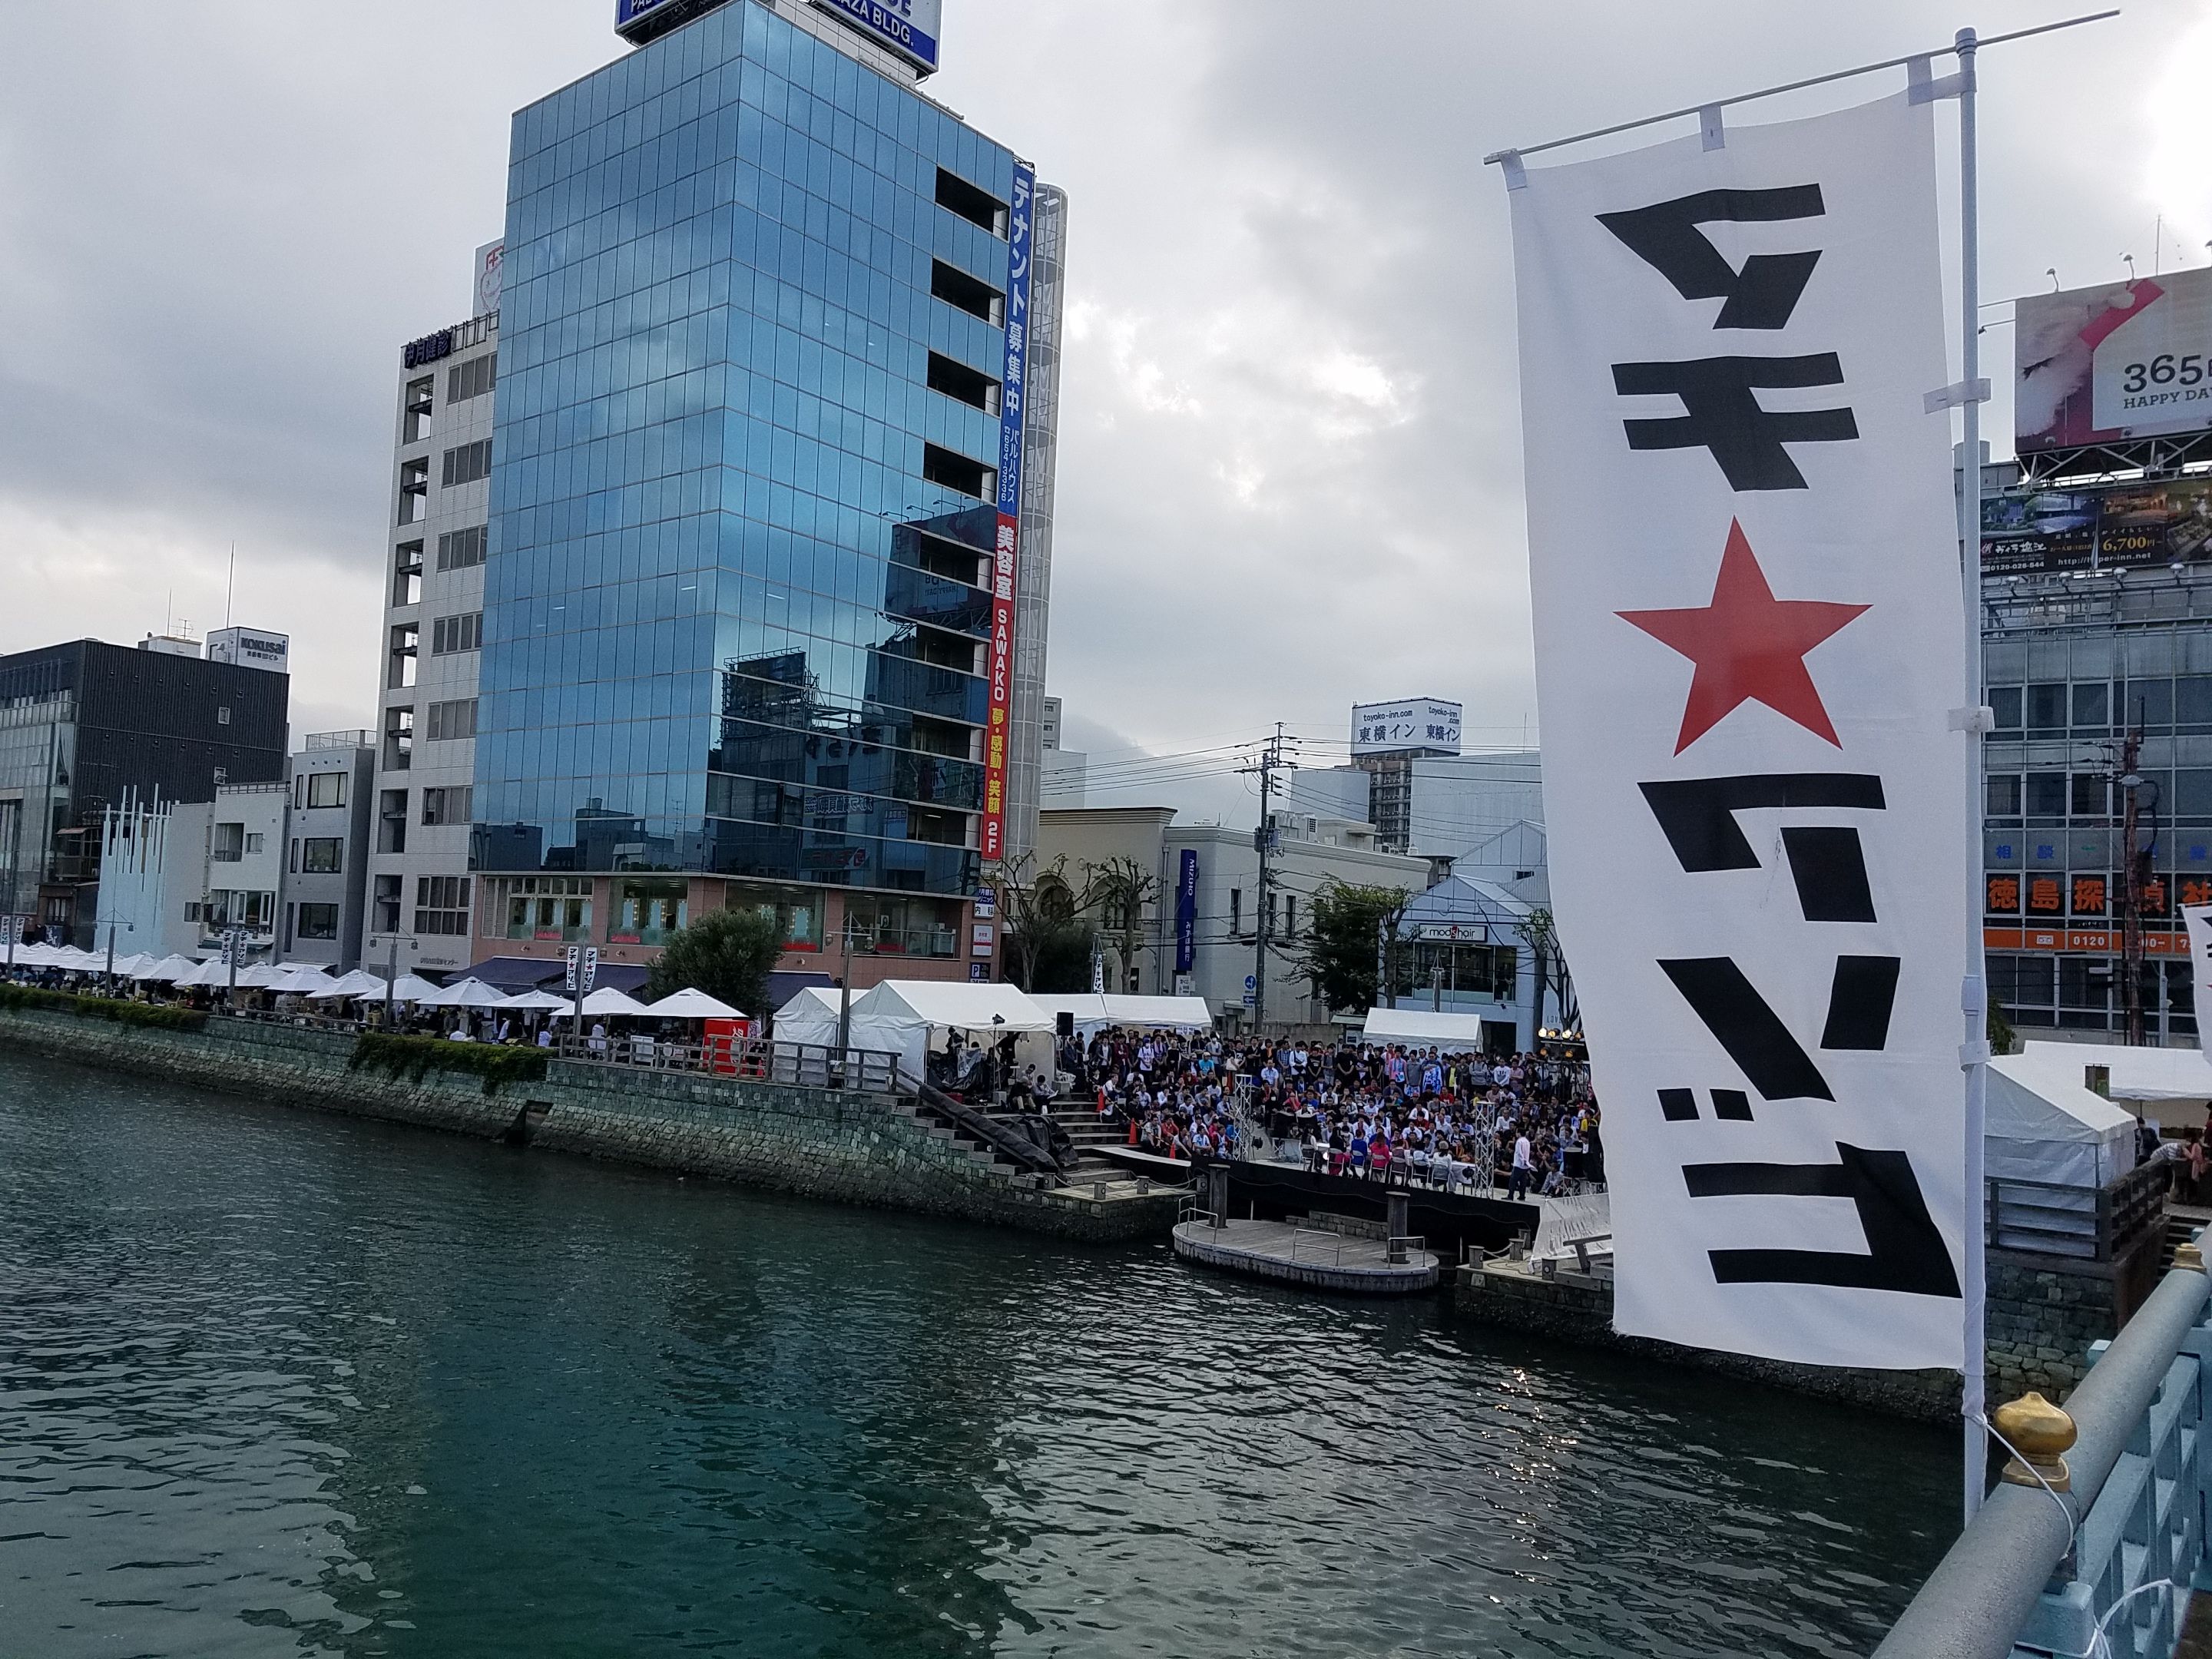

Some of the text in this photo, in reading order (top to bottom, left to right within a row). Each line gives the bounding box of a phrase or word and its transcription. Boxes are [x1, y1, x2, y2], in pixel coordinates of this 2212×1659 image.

[873, 6, 914, 46] BLDG.
[1005, 177, 1029, 416] テナント募集中
[2123, 387, 2212, 409] HAPPY DA
[995, 525, 1015, 601] 美容室
[994, 609, 1008, 702] SAWAKO
[1363, 710, 1413, 723] toyoko-inn.com
[1359, 724, 1416, 743] 東横イン
[1426, 724, 1460, 742] 東横イン
[988, 821, 998, 853] 2F
